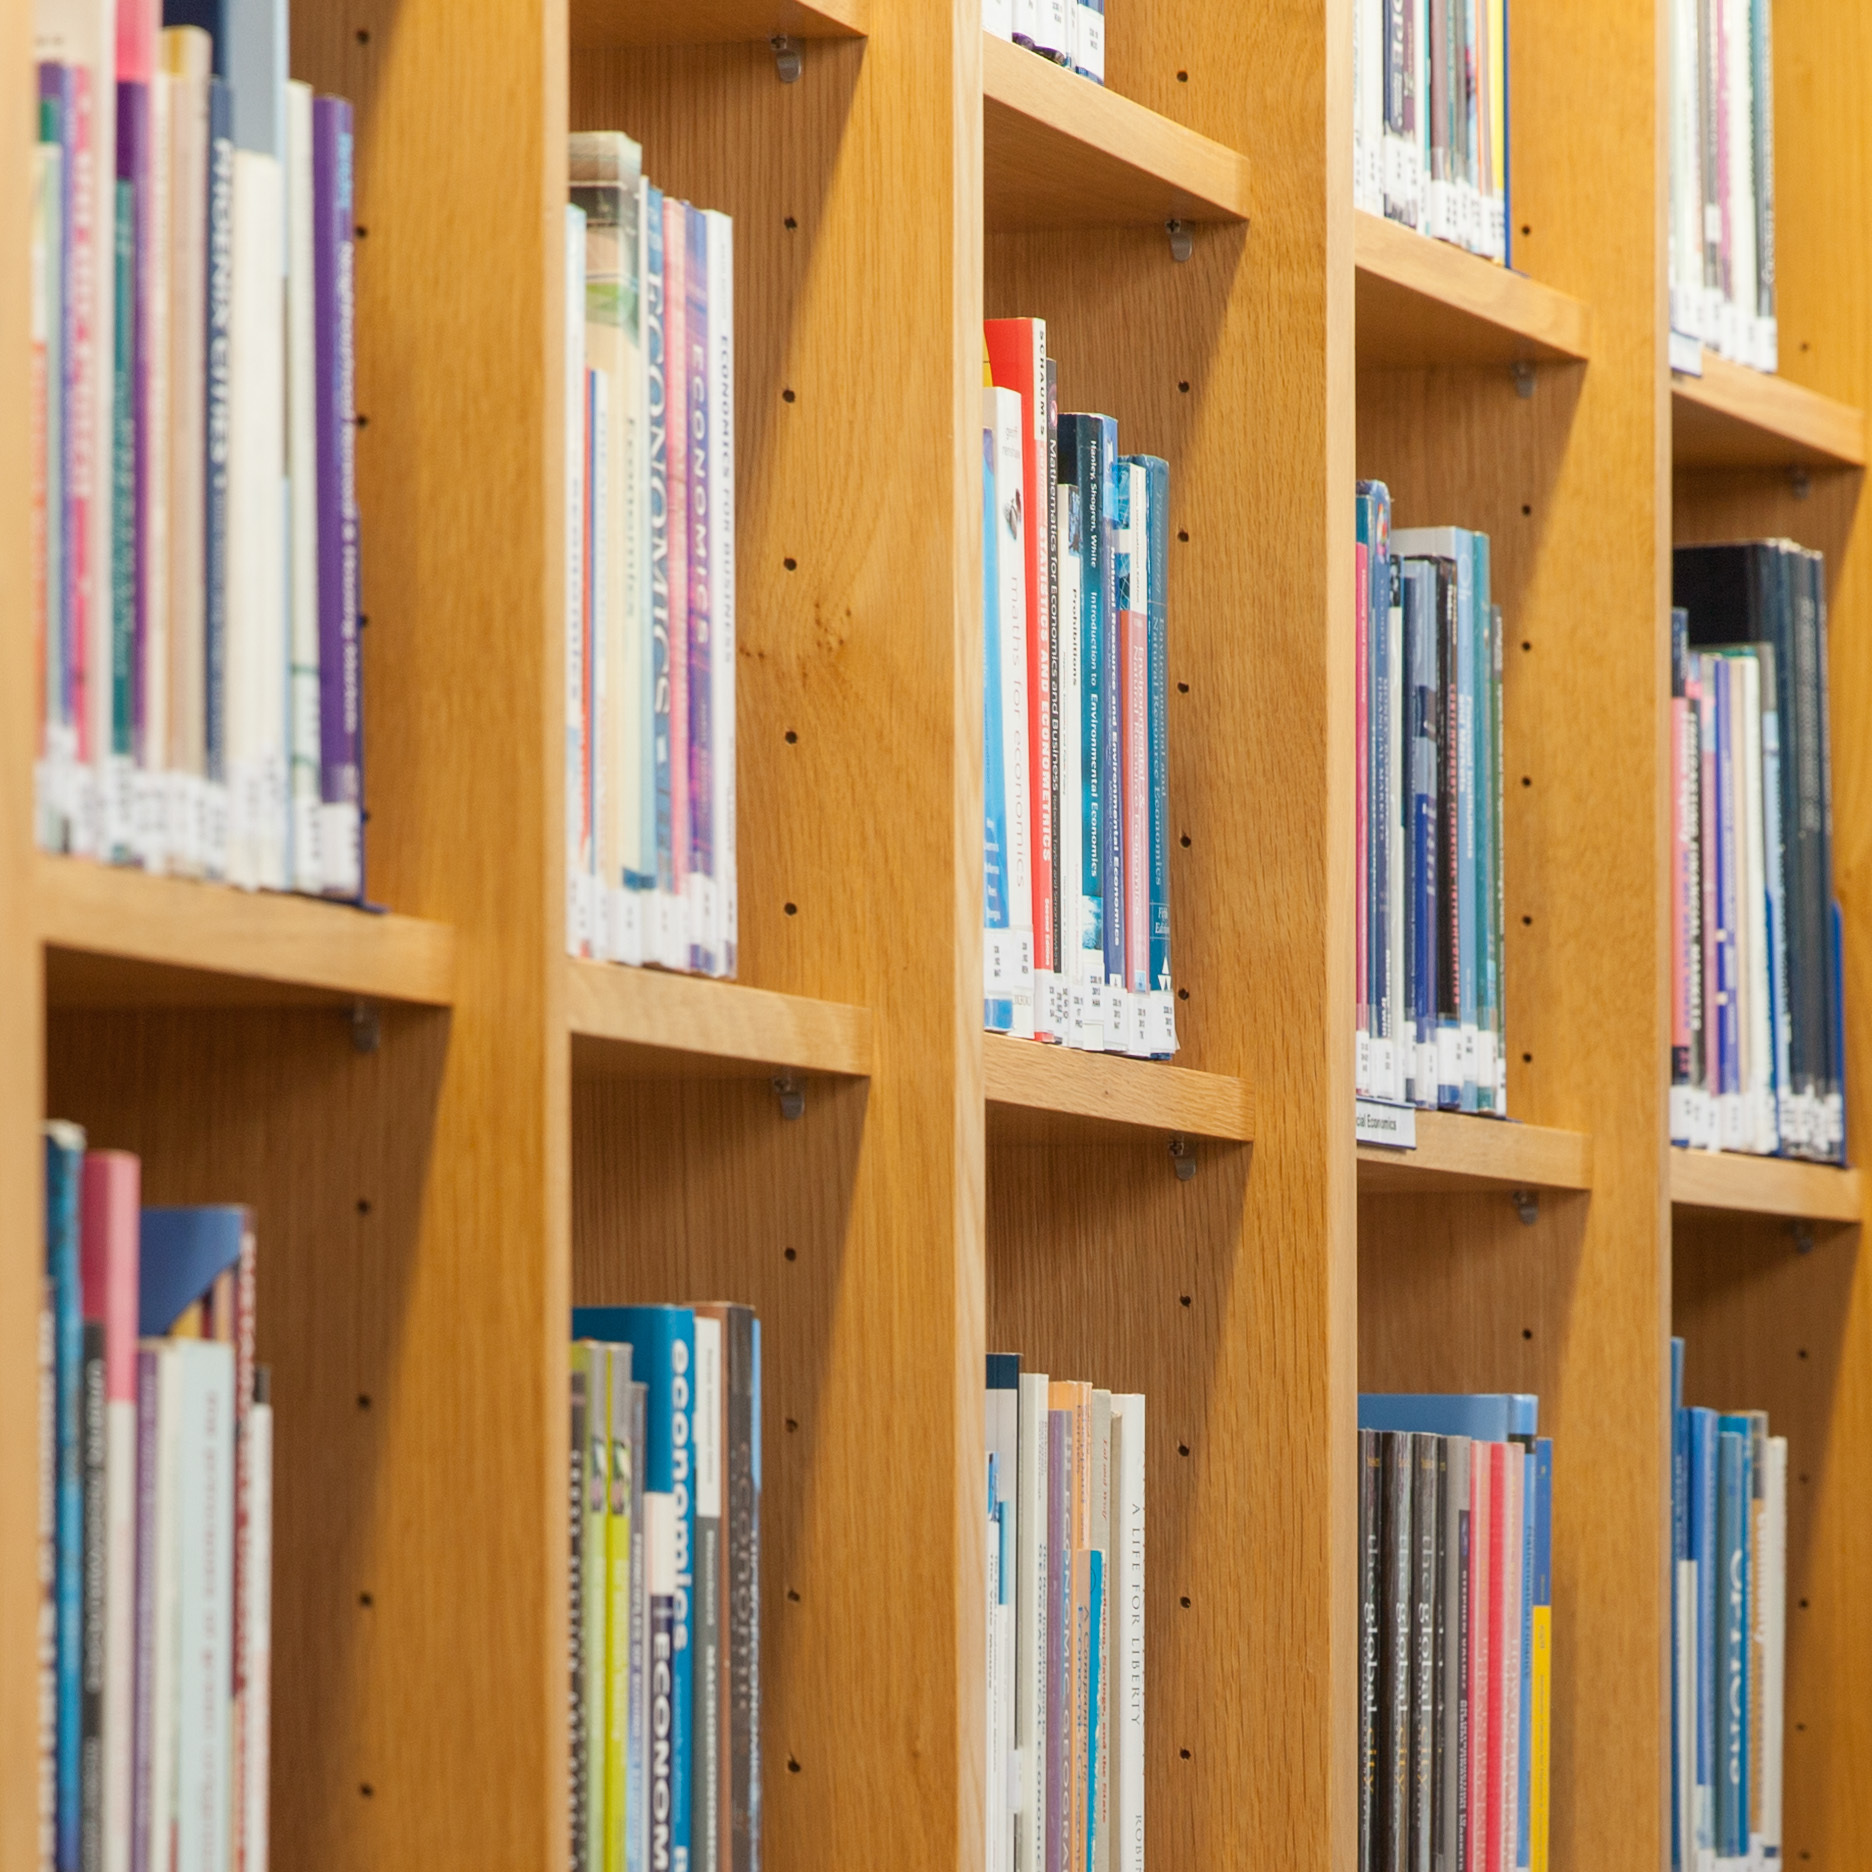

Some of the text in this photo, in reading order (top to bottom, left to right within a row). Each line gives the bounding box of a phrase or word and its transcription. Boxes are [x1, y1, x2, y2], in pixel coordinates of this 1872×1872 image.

[1038, 330, 1047, 437] SCHAUM'S
[646, 270, 670, 715] ECONOMICS
[692, 344, 708, 645] ECONOMICS
[1089, 440, 1098, 568] Hanley, Shogren, White
[1039, 527, 1048, 642] STATISTICS
[1050, 440, 1061, 791] Mathematics for Economics and Business
[1110, 547, 1118, 608] Natural
[1040, 649, 1049, 692] AND
[1110, 612, 1119, 691] Resource
[1011, 577, 1026, 888] maths for economics
[1042, 701, 1051, 862] ECONOMETRICS
[1090, 592, 1100, 876] Introduction to Environmental Economics
[1112, 736, 1120, 852] Environmental
[1153, 786, 1163, 886] Economics
[1113, 857, 1121, 947] Economics
[1367, 1114, 1396, 1131] Economics
[672, 1339, 694, 1650] economics
[1131, 1504, 1141, 1726] A LIFE FOR LIBERTY
[1364, 1534, 1378, 1794] the global city
[1396, 1602, 1408, 1712] global
[1418, 1602, 1432, 1712] global
[1082, 1632, 1090, 1761] Companion
[1394, 1726, 1408, 1794] city
[1417, 1726, 1430, 1791] city
